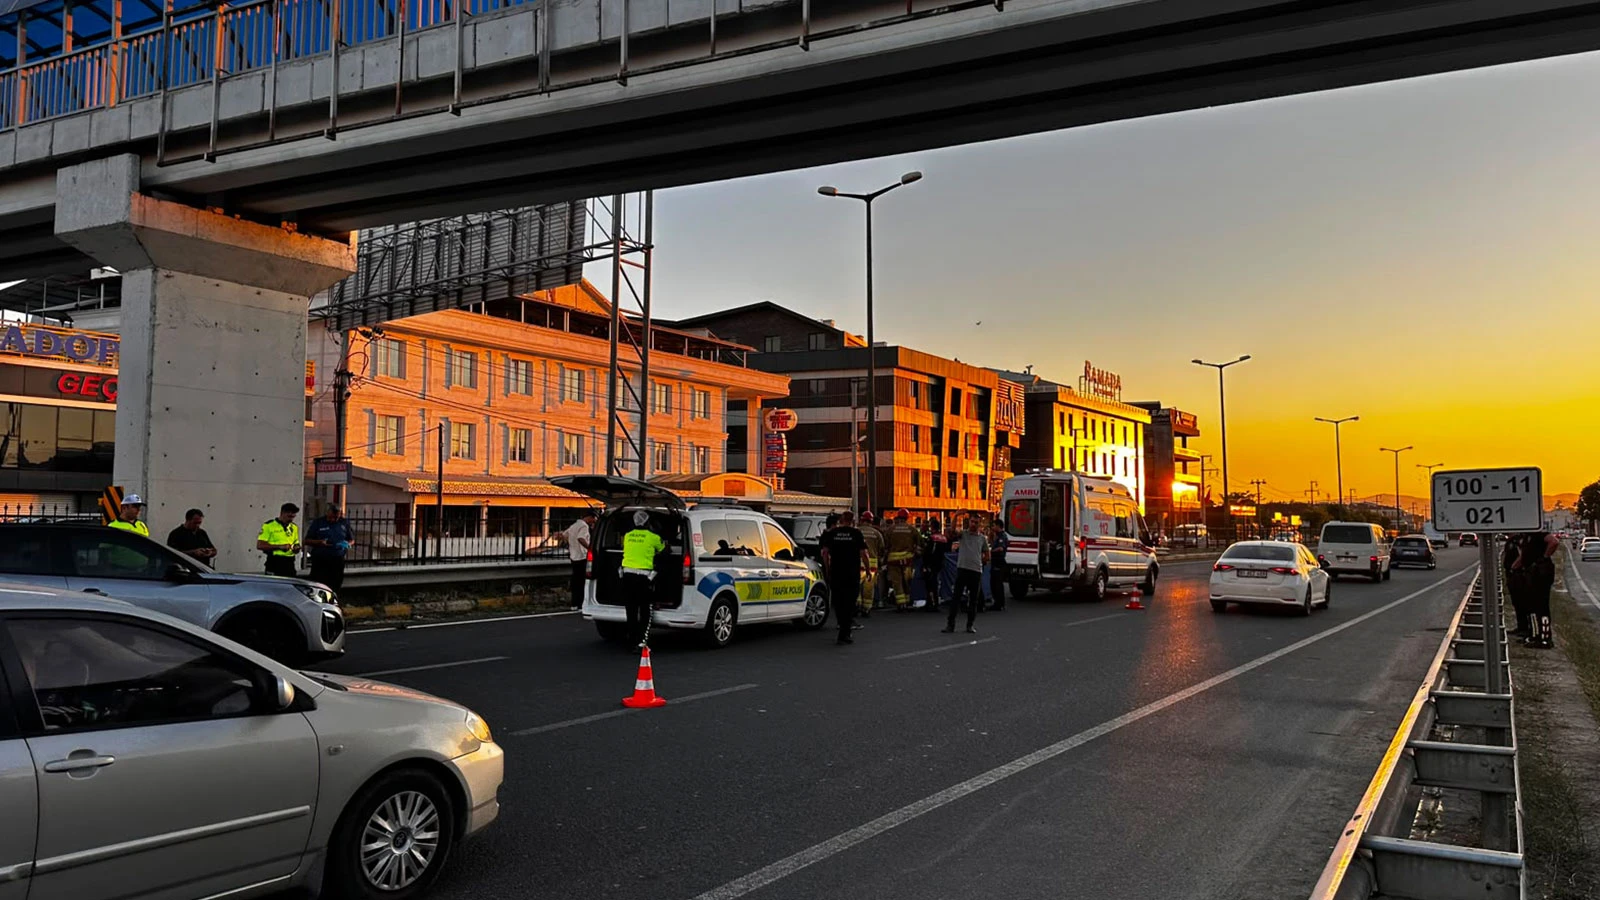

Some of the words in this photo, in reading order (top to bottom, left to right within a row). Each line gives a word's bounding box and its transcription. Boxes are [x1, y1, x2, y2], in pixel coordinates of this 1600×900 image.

[1084, 360, 1121, 391] RAMADA
[771, 421, 789, 429] OTEL
[1443, 478, 1482, 495] 100
[1507, 476, 1530, 493] 11
[1466, 506, 1505, 524] 021
[1099, 523, 1109, 535] 112
